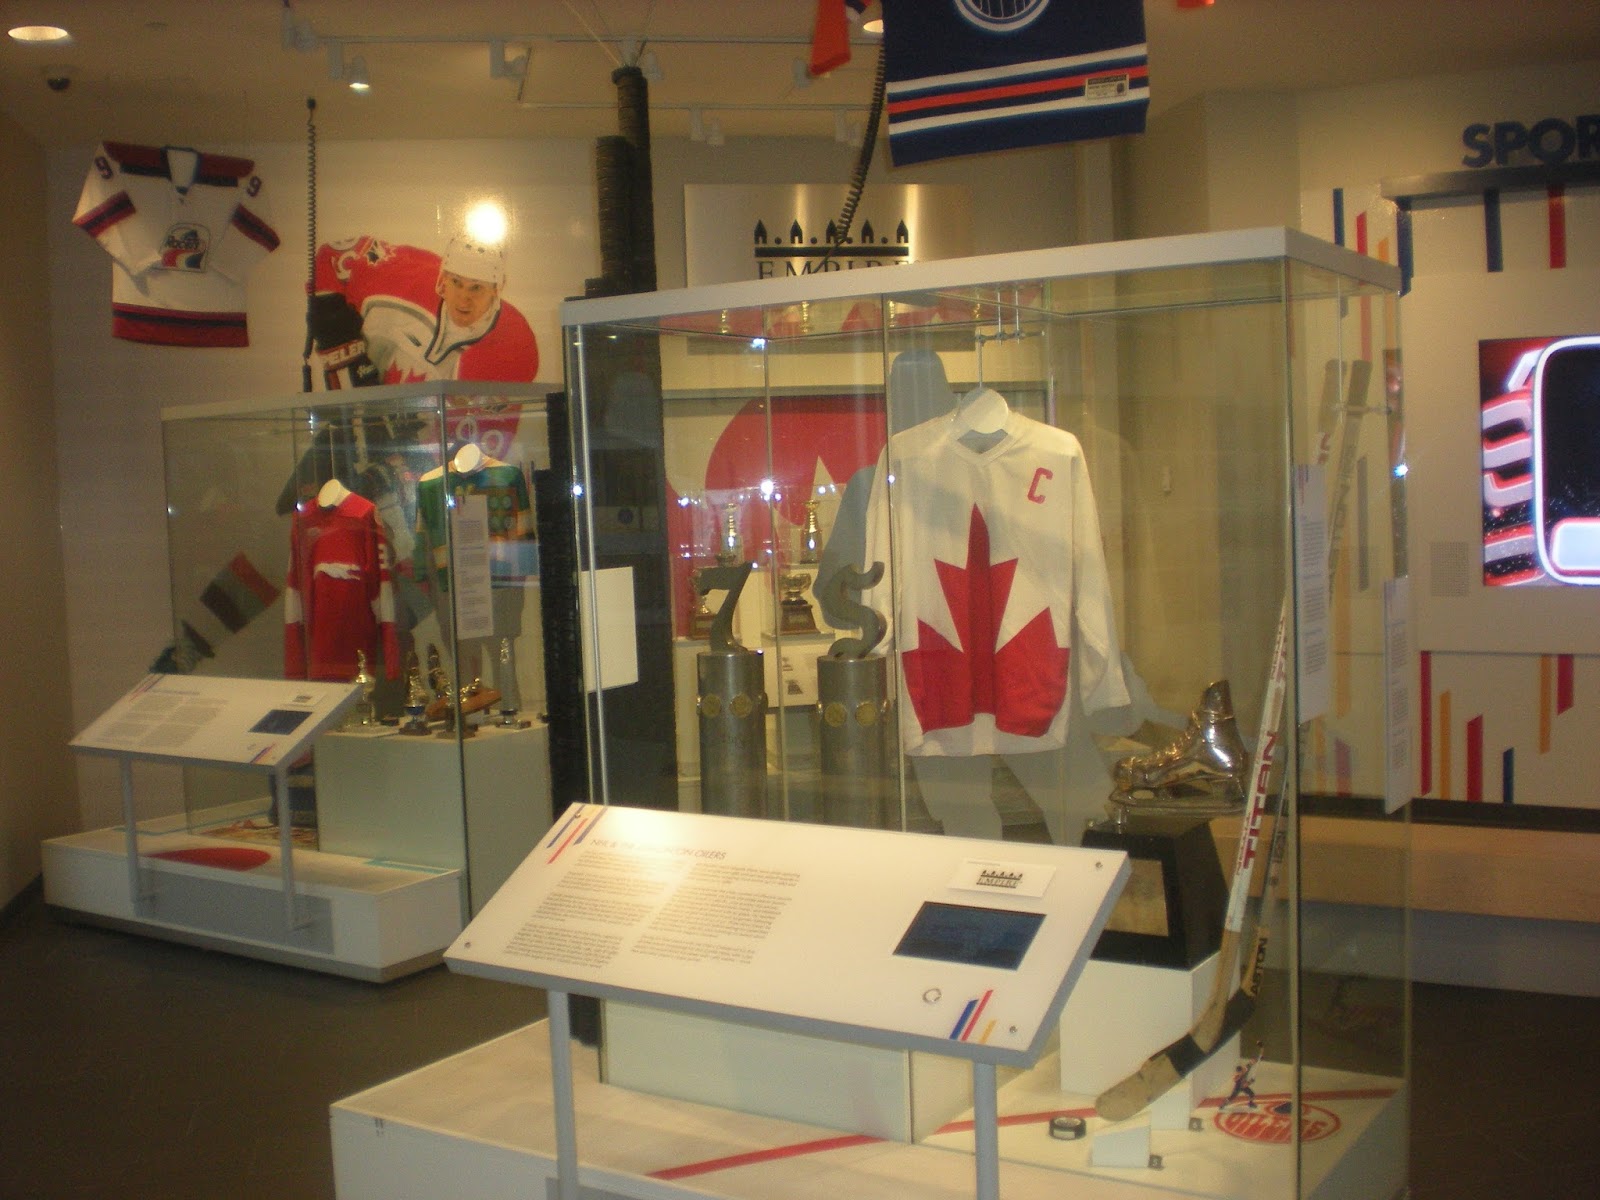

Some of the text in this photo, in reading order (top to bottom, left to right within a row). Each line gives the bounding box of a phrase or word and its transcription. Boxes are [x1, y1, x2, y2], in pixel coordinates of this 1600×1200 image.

[1462, 115, 1600, 168] SPOR
[1027, 467, 1053, 504] C
[1242, 730, 1279, 870] TITAN
[694, 849, 728, 861] OILERS
